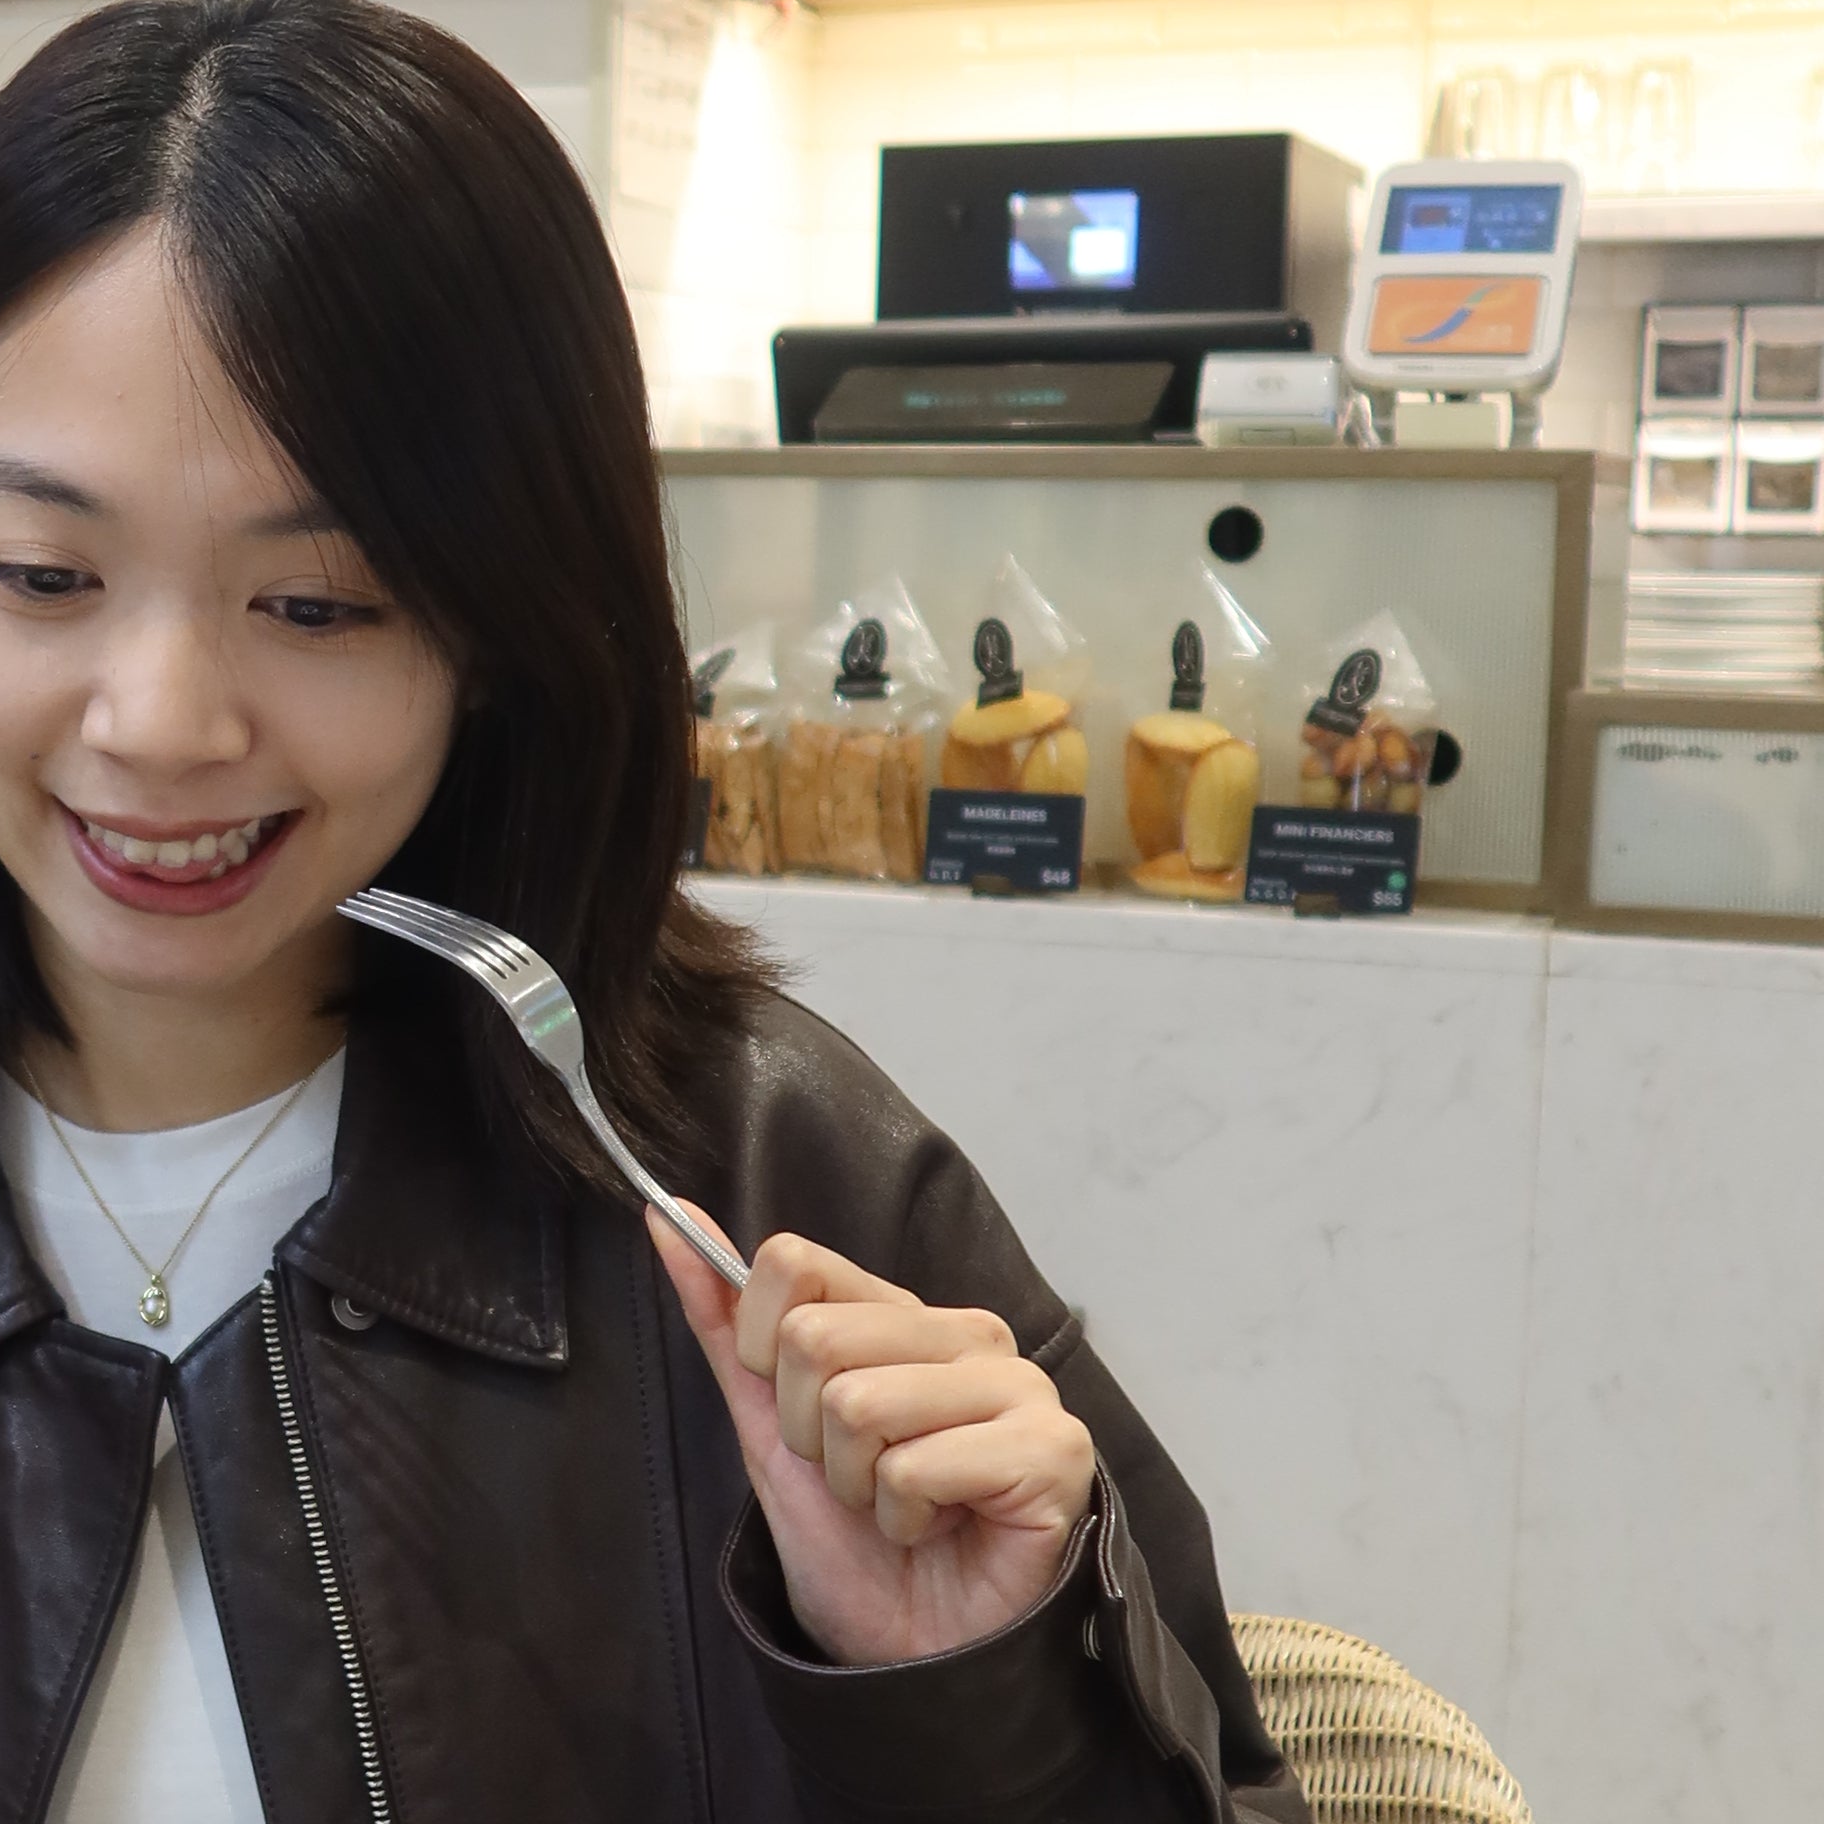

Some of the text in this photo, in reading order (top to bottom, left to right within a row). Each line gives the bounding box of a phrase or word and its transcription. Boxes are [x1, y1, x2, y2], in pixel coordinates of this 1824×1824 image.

[960, 805, 1049, 823] MADELEINES
[1272, 822, 1395, 843] MINI FINANCIERS
